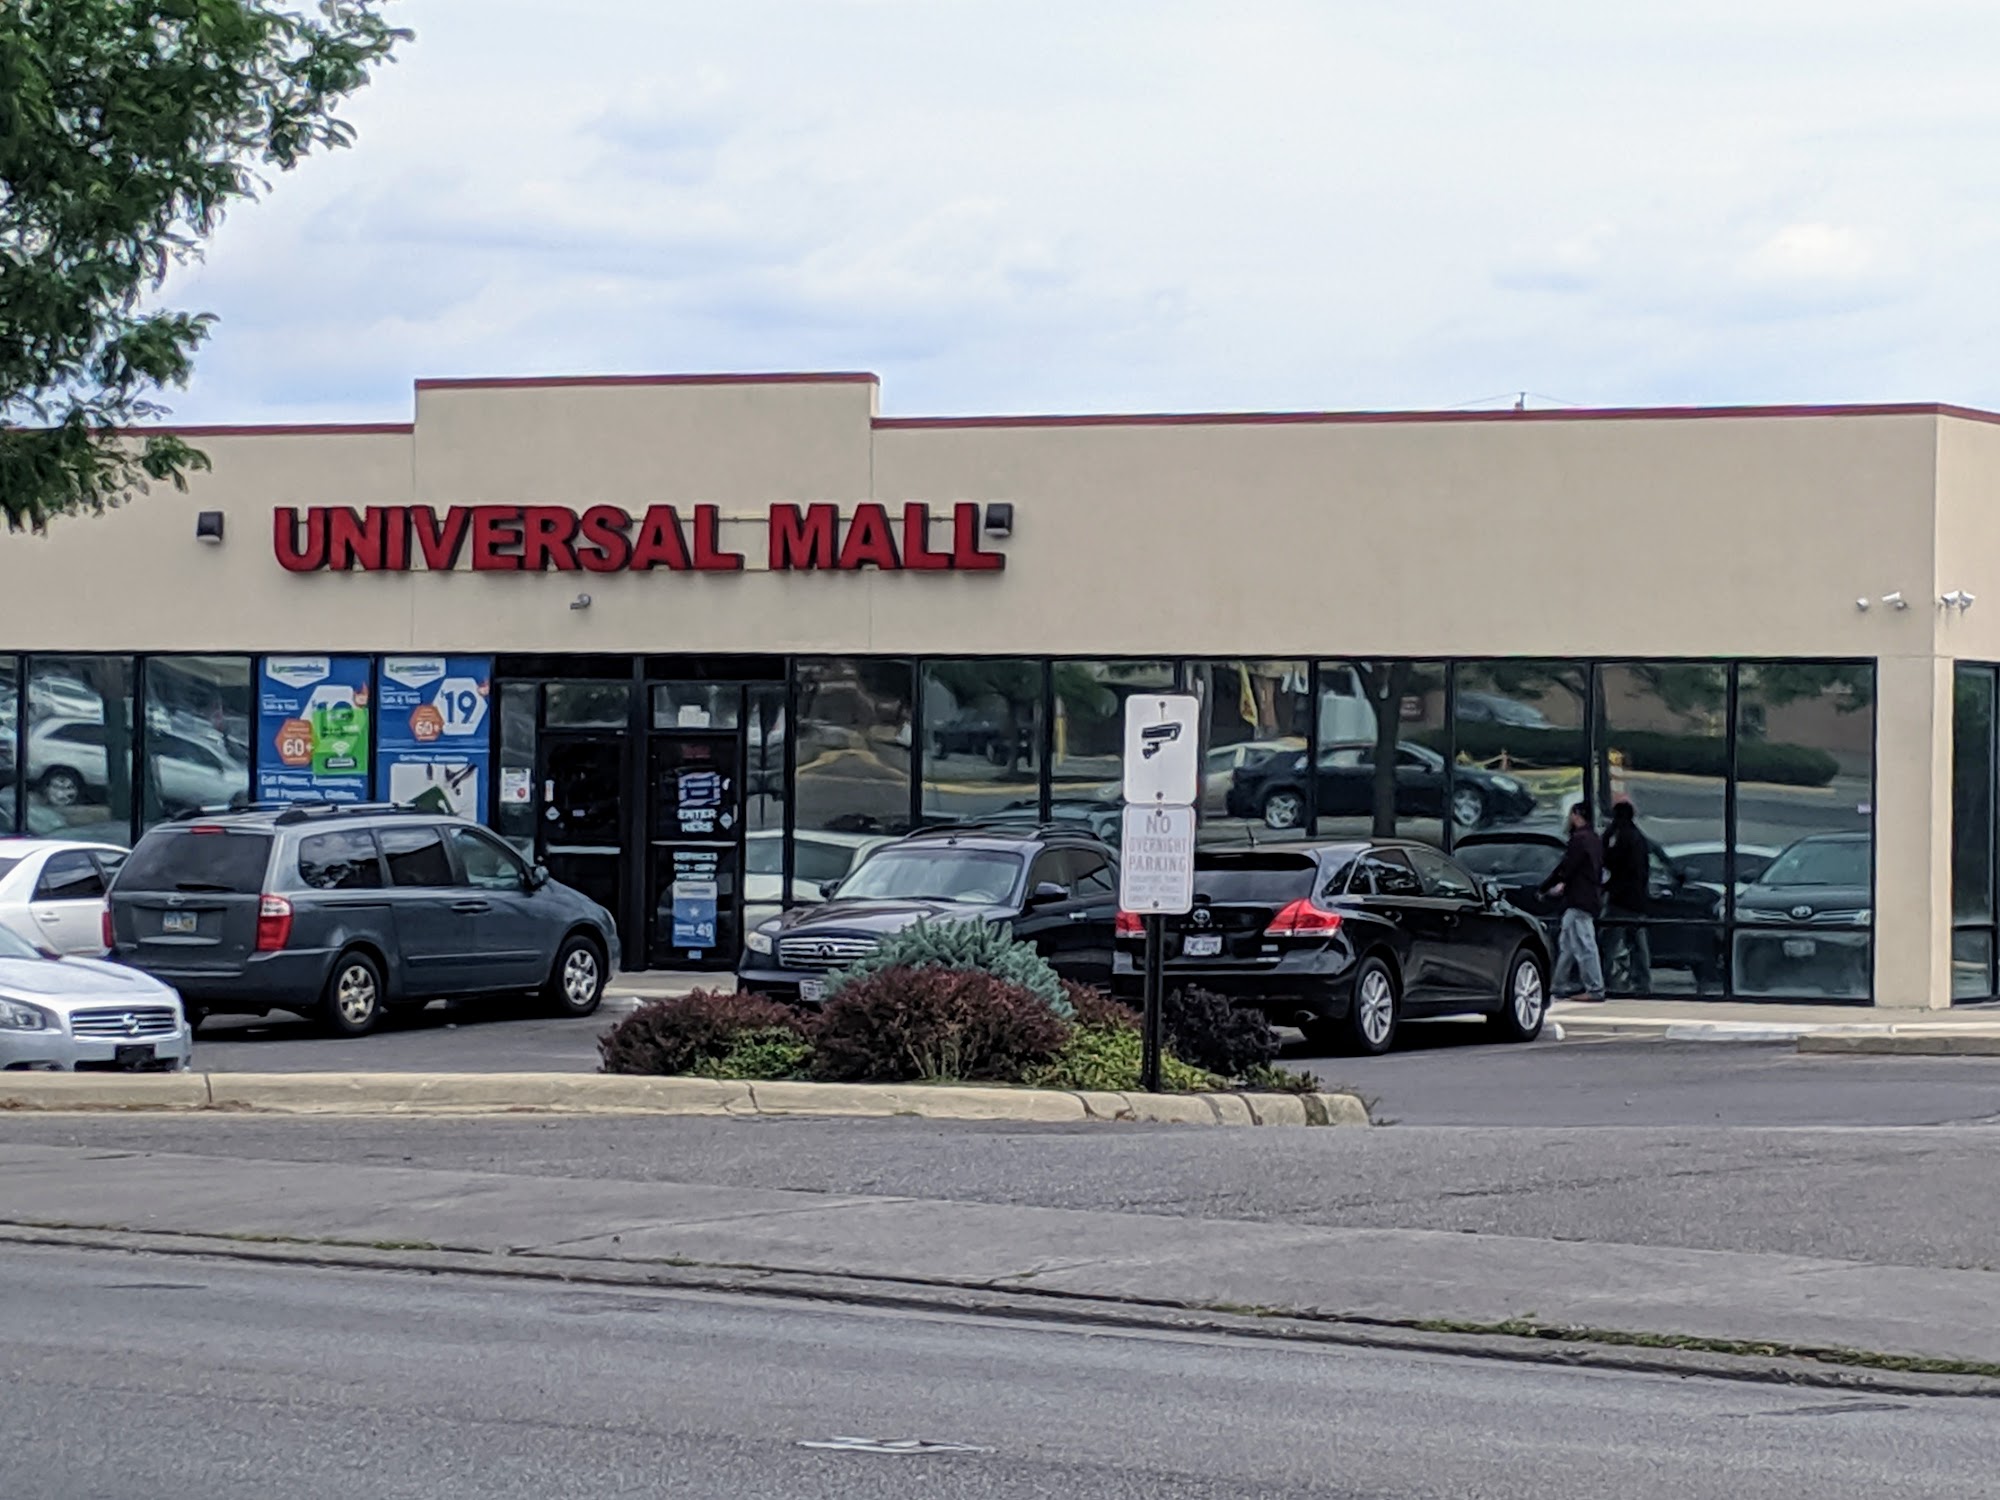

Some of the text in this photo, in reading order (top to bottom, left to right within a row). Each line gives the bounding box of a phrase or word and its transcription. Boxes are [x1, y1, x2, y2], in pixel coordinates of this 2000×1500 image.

[274, 502, 1005, 573] UNIVERSAL MALL
[677, 808, 717, 819] ENTER
[1146, 815, 1172, 834] NO
[1128, 836, 1187, 853] OVERNIGHT
[1128, 855, 1186, 873] PARKING
